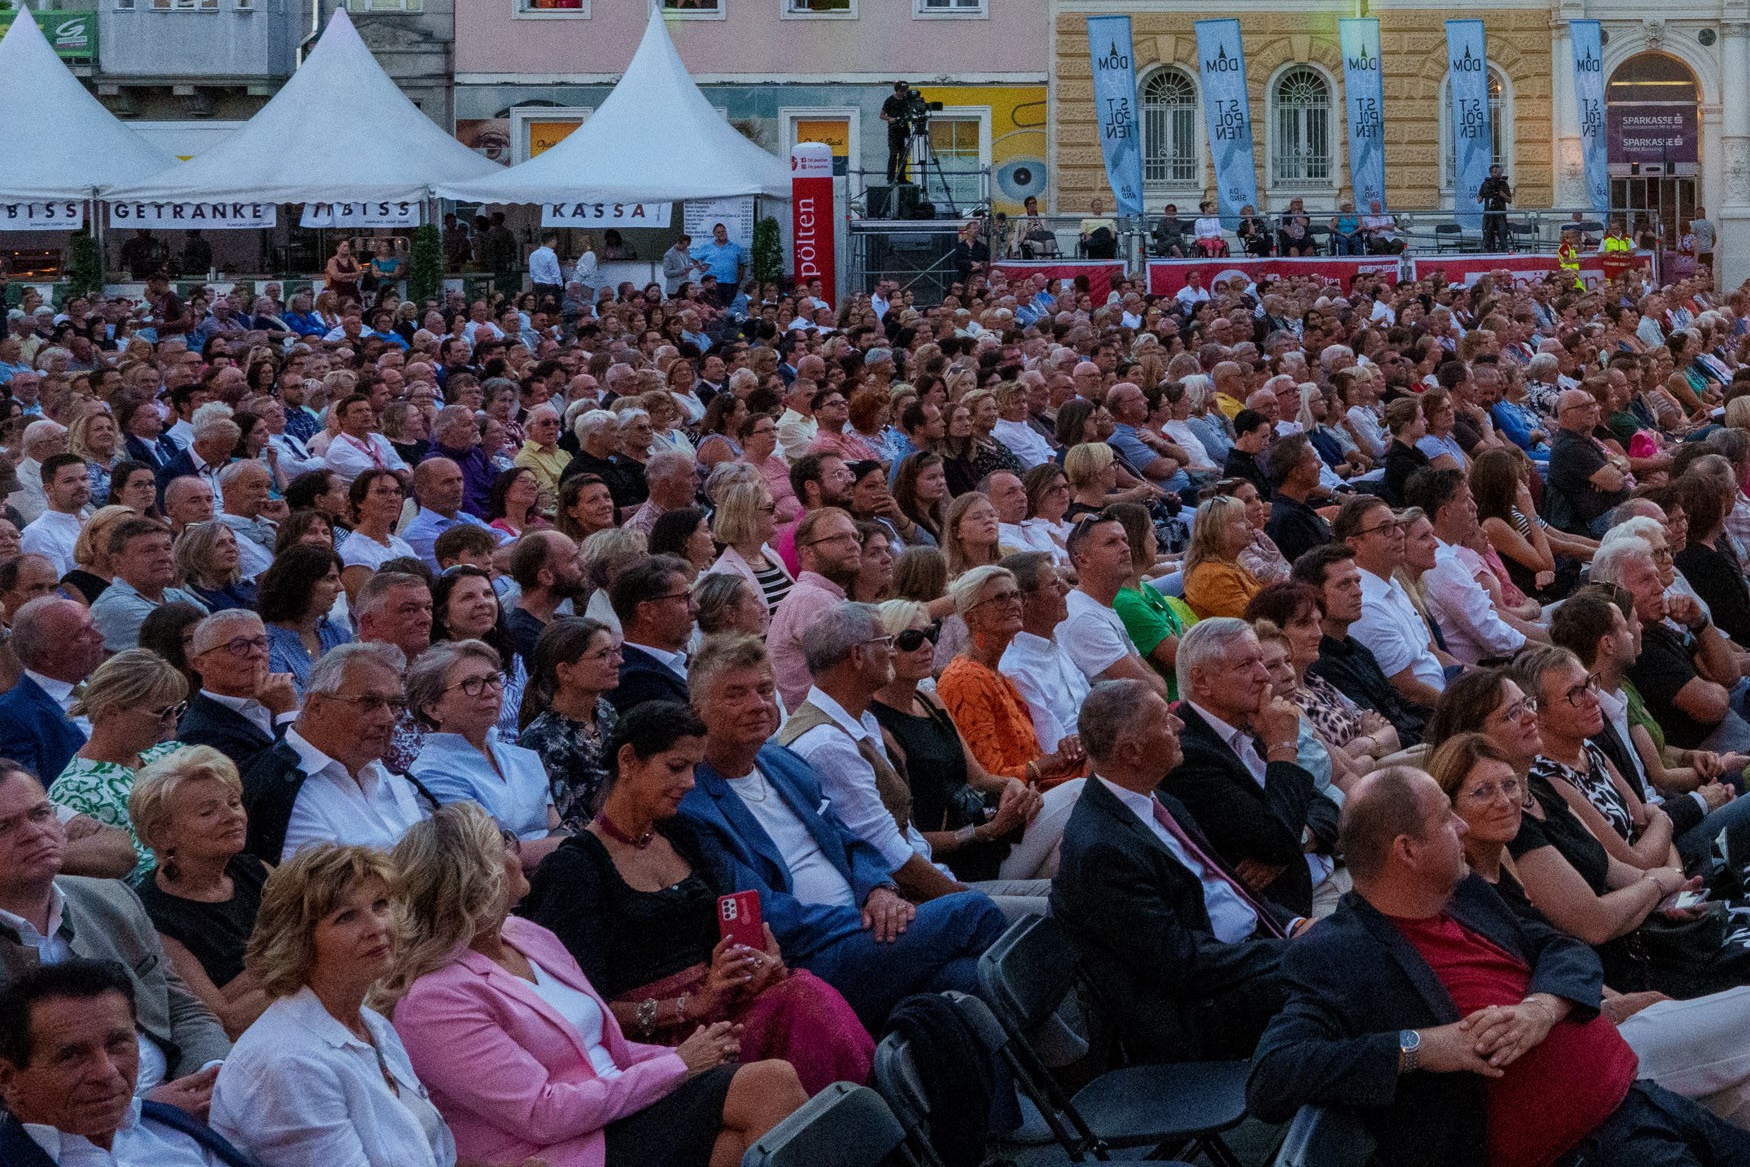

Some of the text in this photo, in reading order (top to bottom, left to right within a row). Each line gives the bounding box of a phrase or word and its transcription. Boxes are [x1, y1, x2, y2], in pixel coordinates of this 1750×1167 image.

[1622, 116, 1674, 125] SPARKASSE
[552, 203, 646, 219] KASSA
[796, 196, 822, 278] pölten
